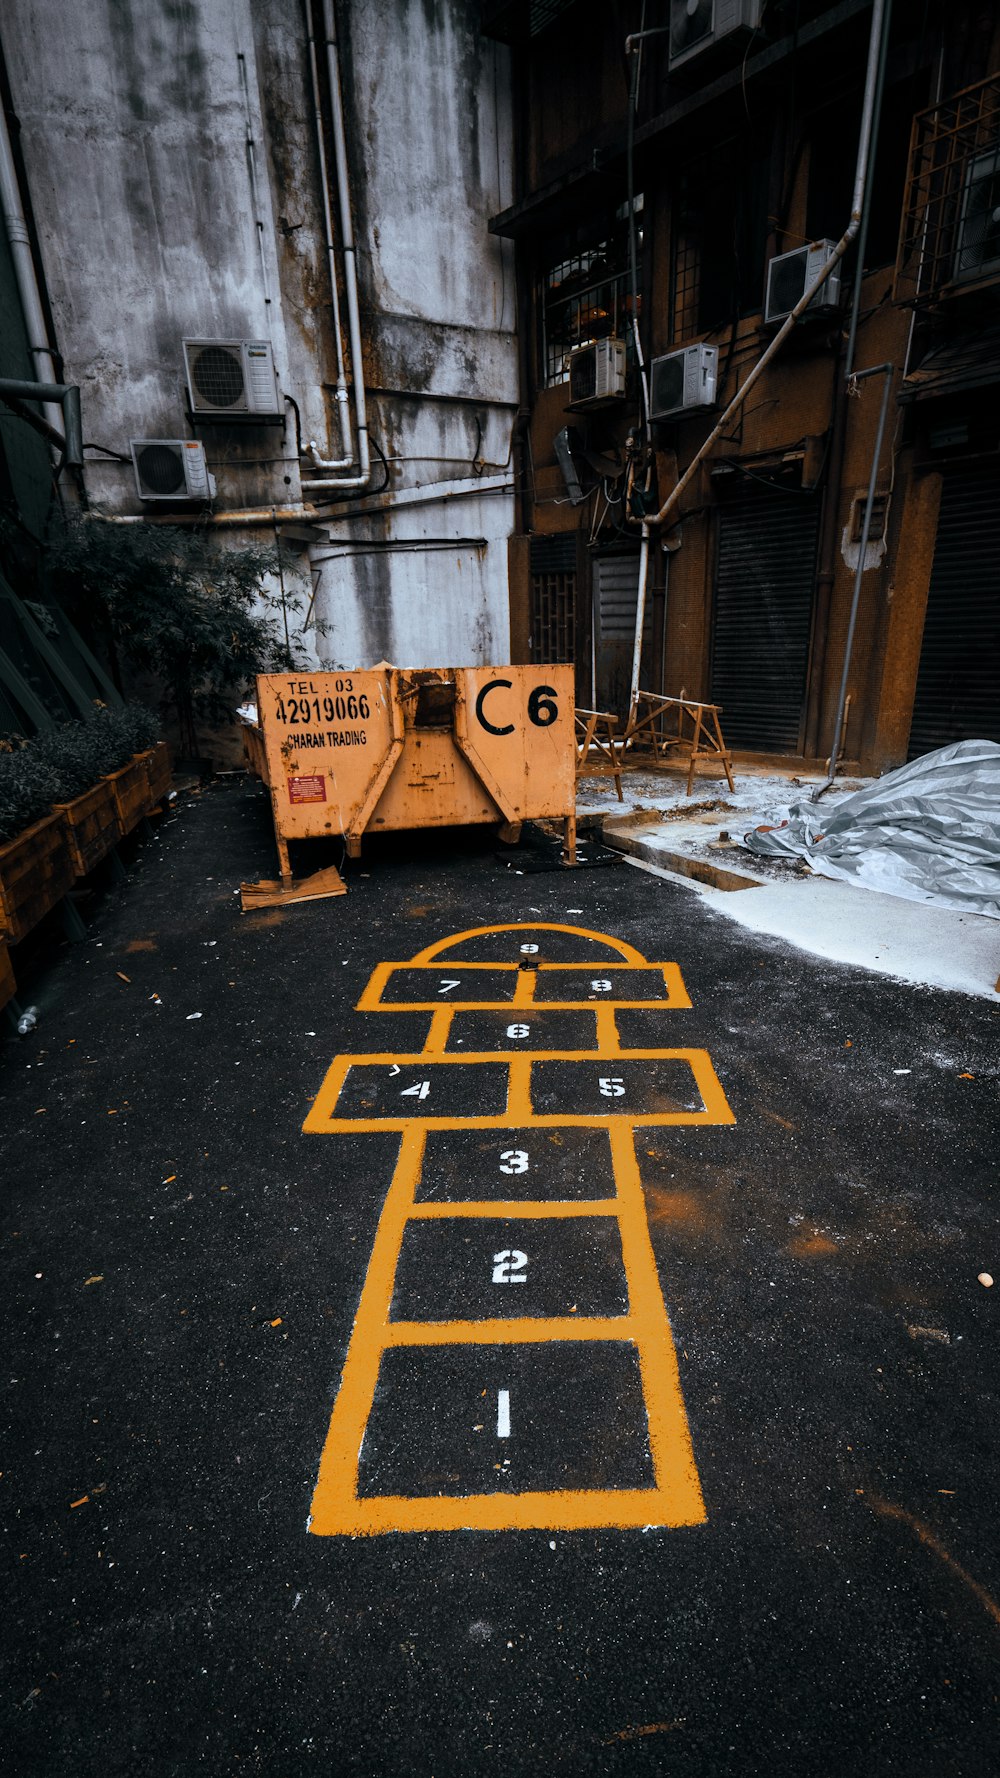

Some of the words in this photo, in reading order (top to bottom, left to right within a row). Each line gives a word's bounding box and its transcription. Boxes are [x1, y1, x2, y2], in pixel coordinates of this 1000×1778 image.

[287, 682, 319, 694] TEL
[335, 679, 353, 692] 03
[276, 694, 370, 724] 42919066
[475, 679, 515, 736] C
[527, 685, 559, 727] 6
[287, 732, 325, 749] CHARAN
[327, 730, 367, 747] TRADING
[520, 943, 539, 954] 9
[438, 980, 461, 993] 7
[591, 979, 613, 992] 8
[507, 1023, 530, 1039] 6
[401, 1080, 431, 1100] 4
[599, 1078, 626, 1097] 5
[499, 1149, 529, 1175] 3
[491, 1249, 529, 1284] 2
